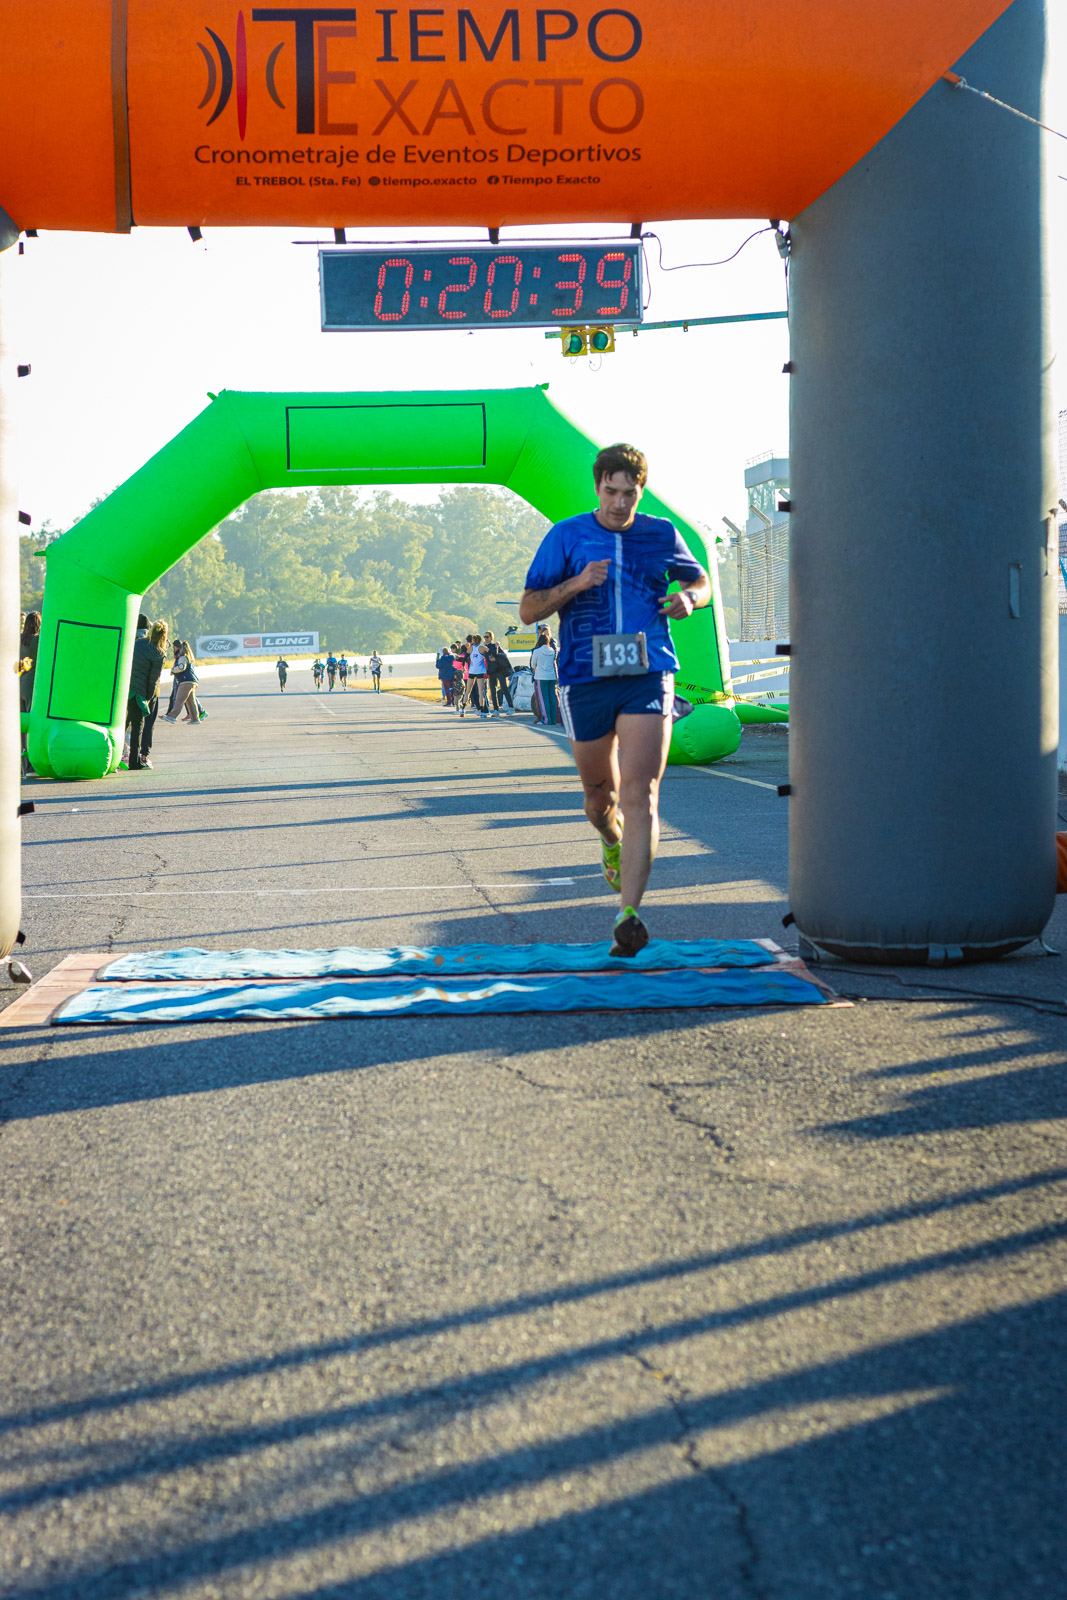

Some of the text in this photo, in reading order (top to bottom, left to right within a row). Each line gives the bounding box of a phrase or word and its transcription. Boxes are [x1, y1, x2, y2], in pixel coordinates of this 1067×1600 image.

[194, 144, 641, 168] Cronometraje de Eventos Deportivos
[236, 176, 361, 187] EL TREBOL (Sta. Fe)
[382, 175, 477, 188] tiempo.exacto
[501, 174, 601, 187] Tiempo Exacto
[373, 252, 632, 322] 0:20:39
[206, 640, 231, 651] Ford
[264, 636, 311, 646] LONG
[603, 642, 639, 666] 133
